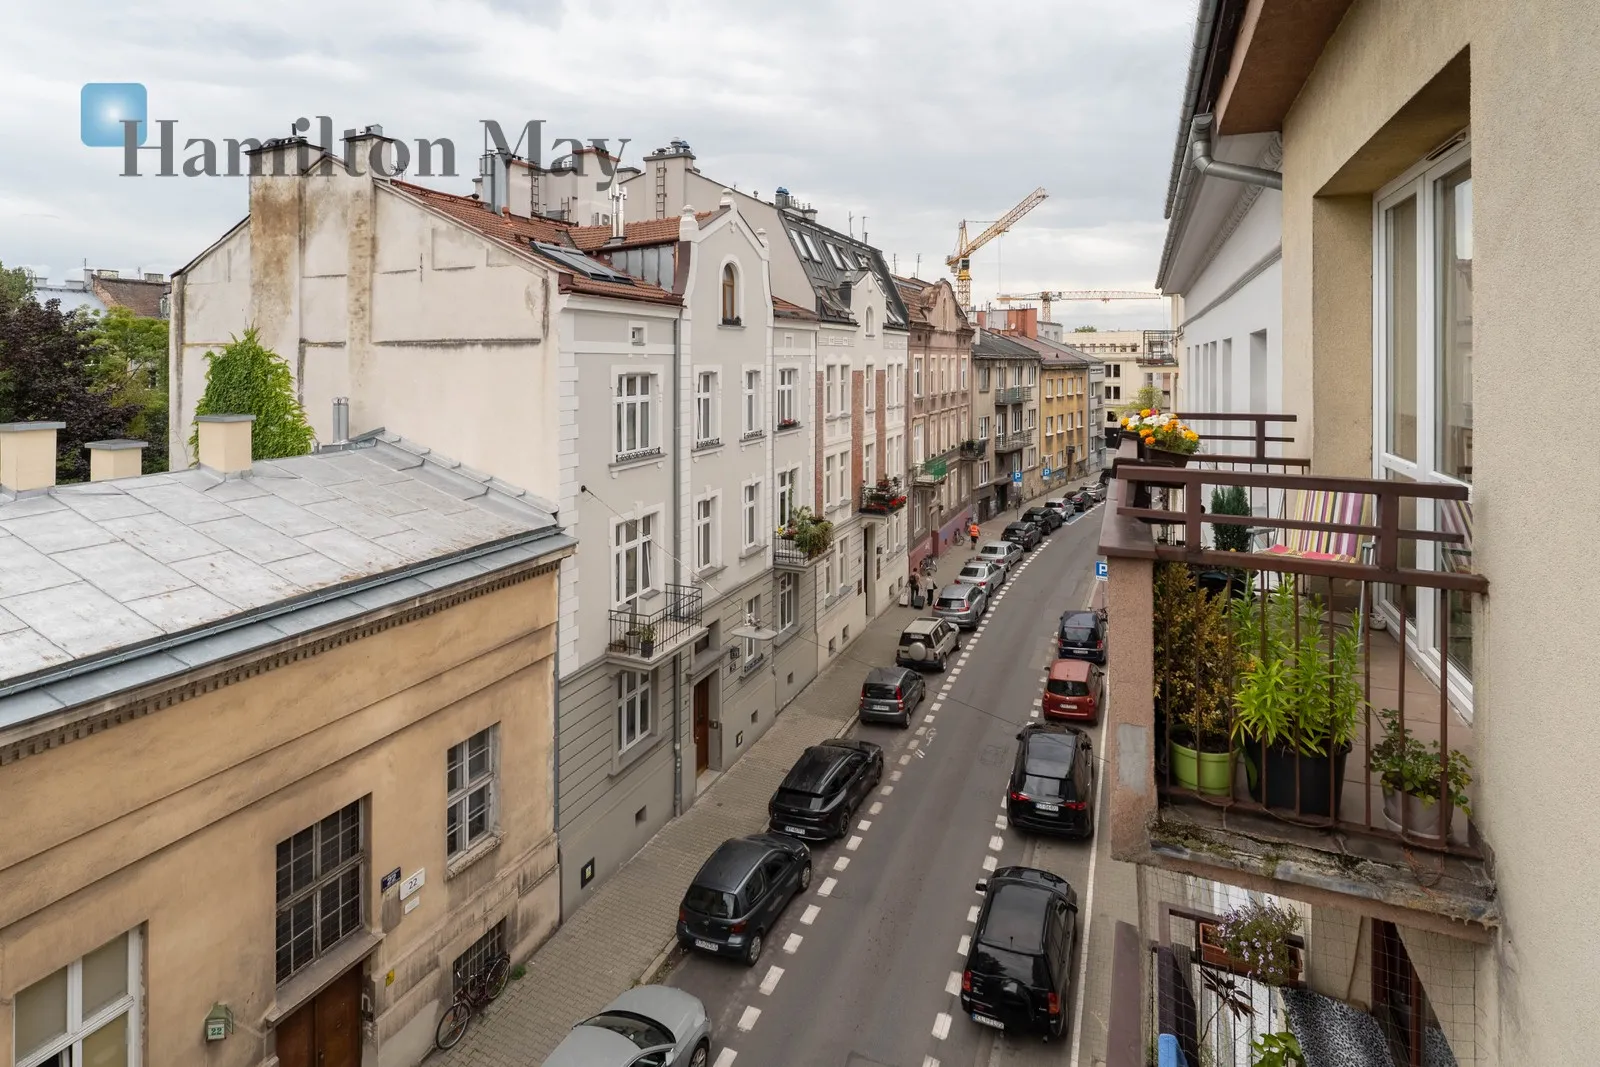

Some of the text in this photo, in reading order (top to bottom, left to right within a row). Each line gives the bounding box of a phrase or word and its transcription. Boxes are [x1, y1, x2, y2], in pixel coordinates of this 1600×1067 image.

[1099, 564, 1108, 575] P
[387, 873, 397, 886] 22
[408, 877, 418, 890] 22
[211, 1027, 222, 1036] 22
